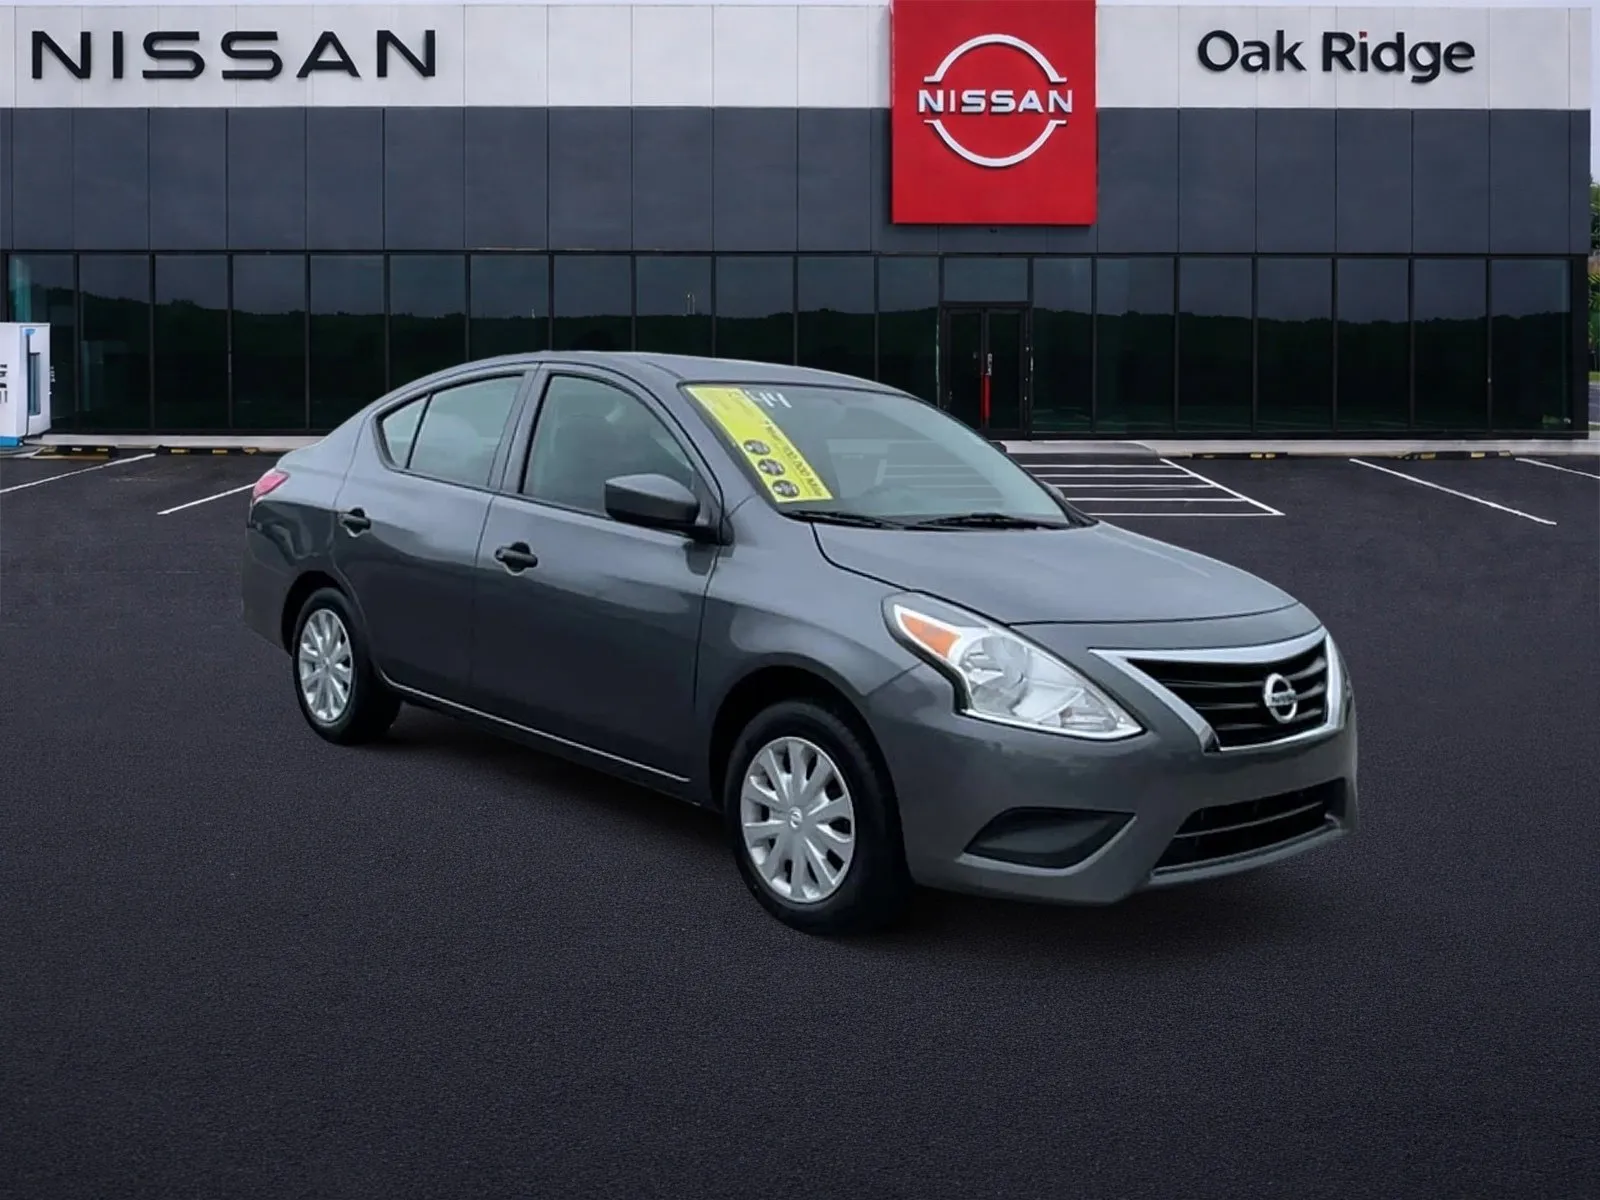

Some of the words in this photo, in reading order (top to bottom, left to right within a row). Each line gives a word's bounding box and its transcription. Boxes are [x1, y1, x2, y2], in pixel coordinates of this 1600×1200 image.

[32, 30, 436, 80] NISSAN
[1198, 30, 1305, 73] Oak
[1322, 31, 1476, 84] Ridge
[918, 88, 1073, 114] NISSAN
